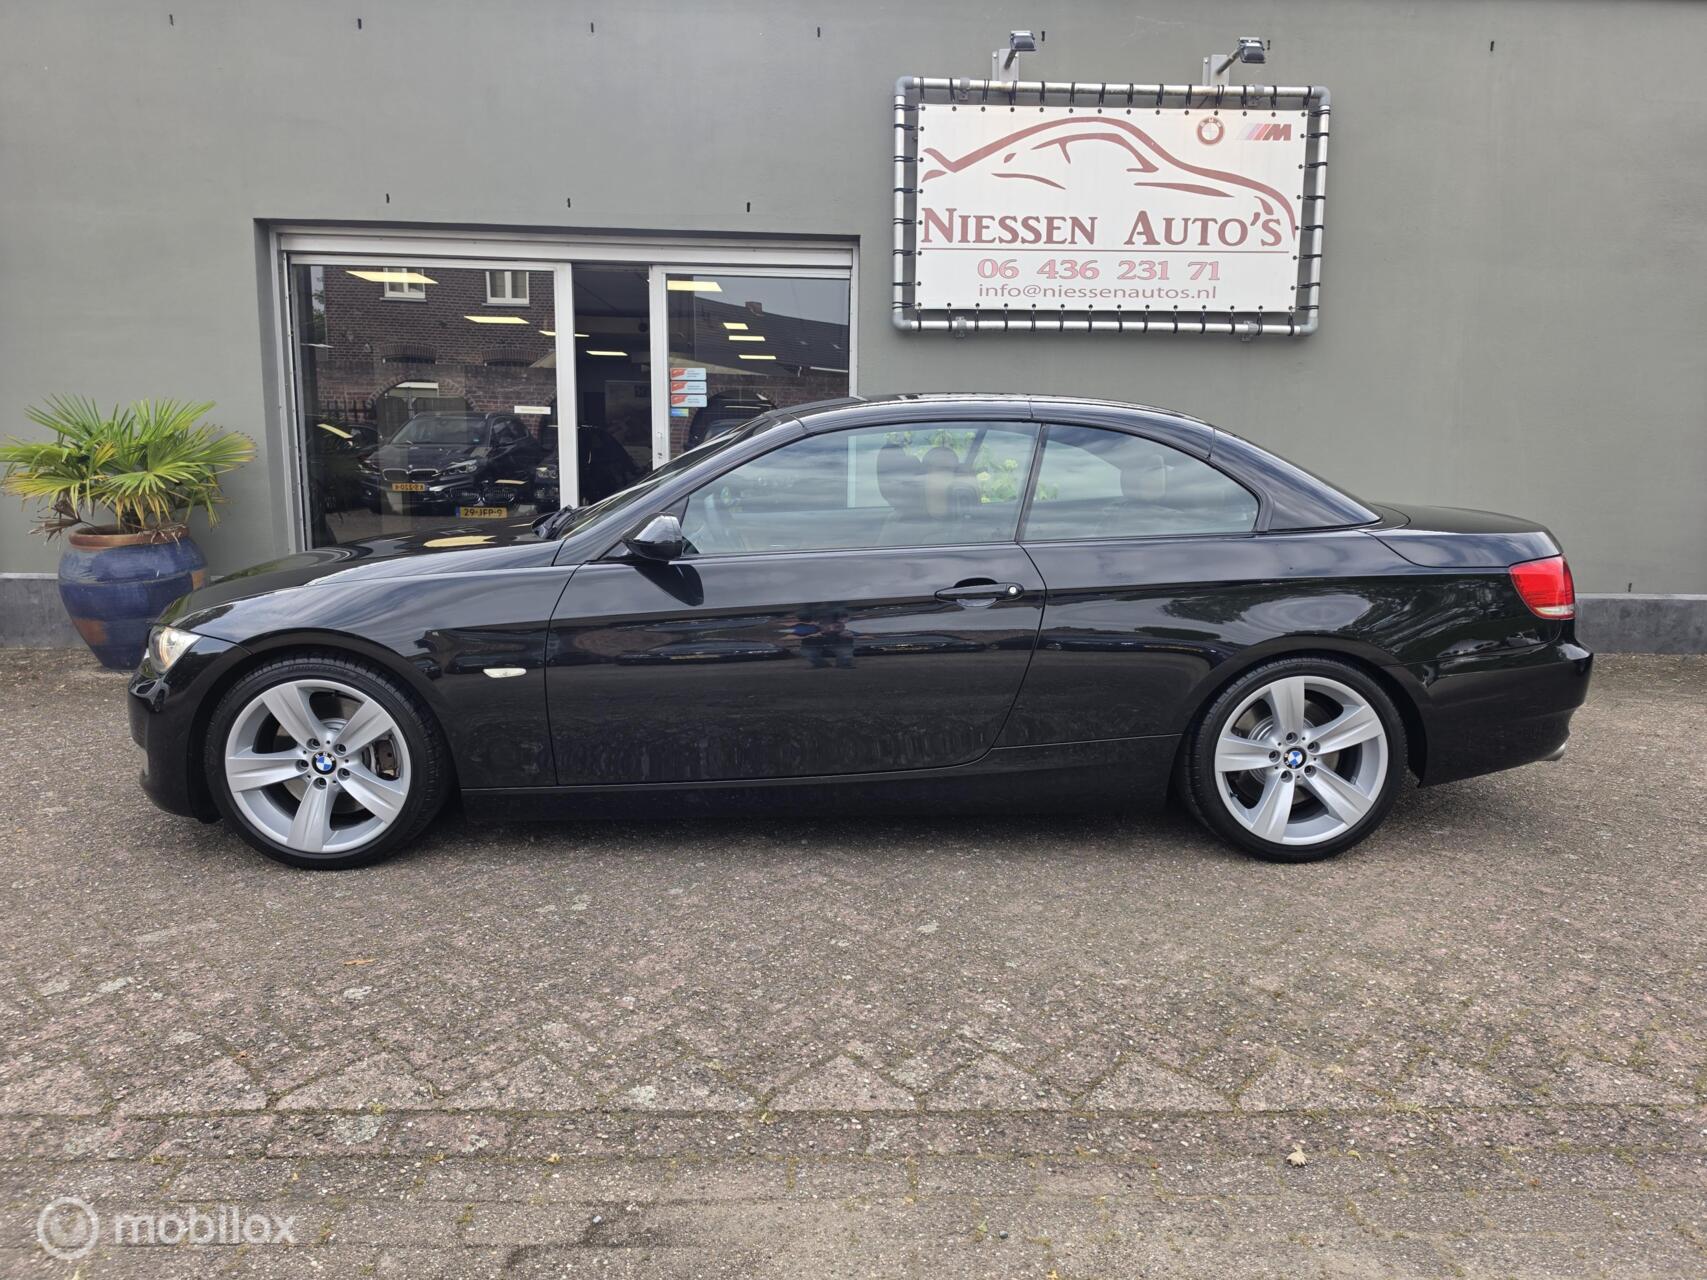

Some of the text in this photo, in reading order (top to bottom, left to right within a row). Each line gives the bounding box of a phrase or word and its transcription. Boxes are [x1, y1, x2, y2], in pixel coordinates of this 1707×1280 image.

[921, 208, 1098, 245] NIESSEN
[977, 258, 1220, 281] 06 436 231 71
[978, 284, 1217, 300] info@niessenautos.nl
